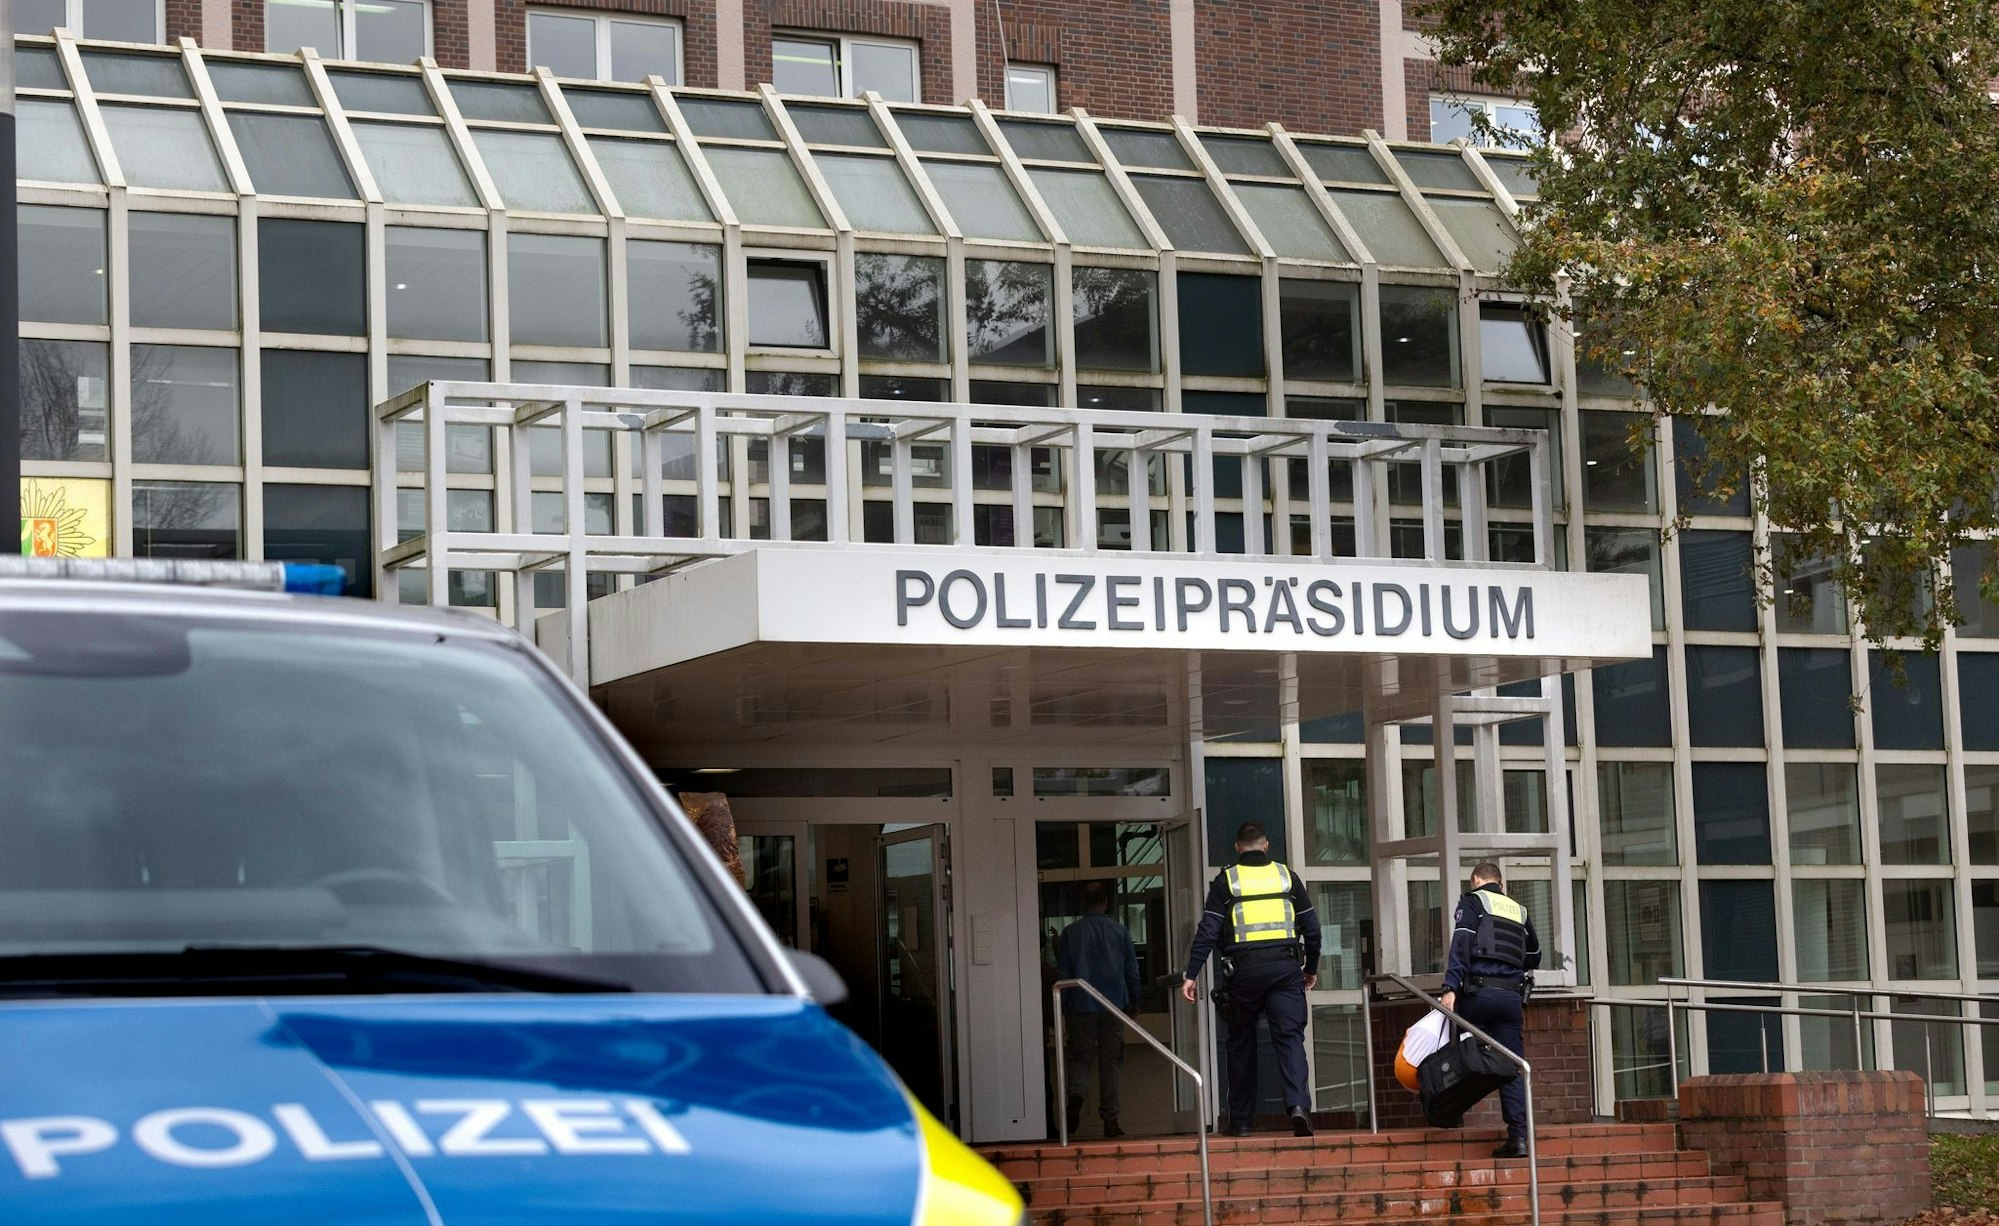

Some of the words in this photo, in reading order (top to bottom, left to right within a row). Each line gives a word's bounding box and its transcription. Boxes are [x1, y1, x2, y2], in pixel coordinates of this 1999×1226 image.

[896, 569, 1534, 640] POLIZEIPRÄSIDIUM
[1492, 900, 1520, 916] POLIZEI
[1, 1100, 692, 1179] POLIZEI
